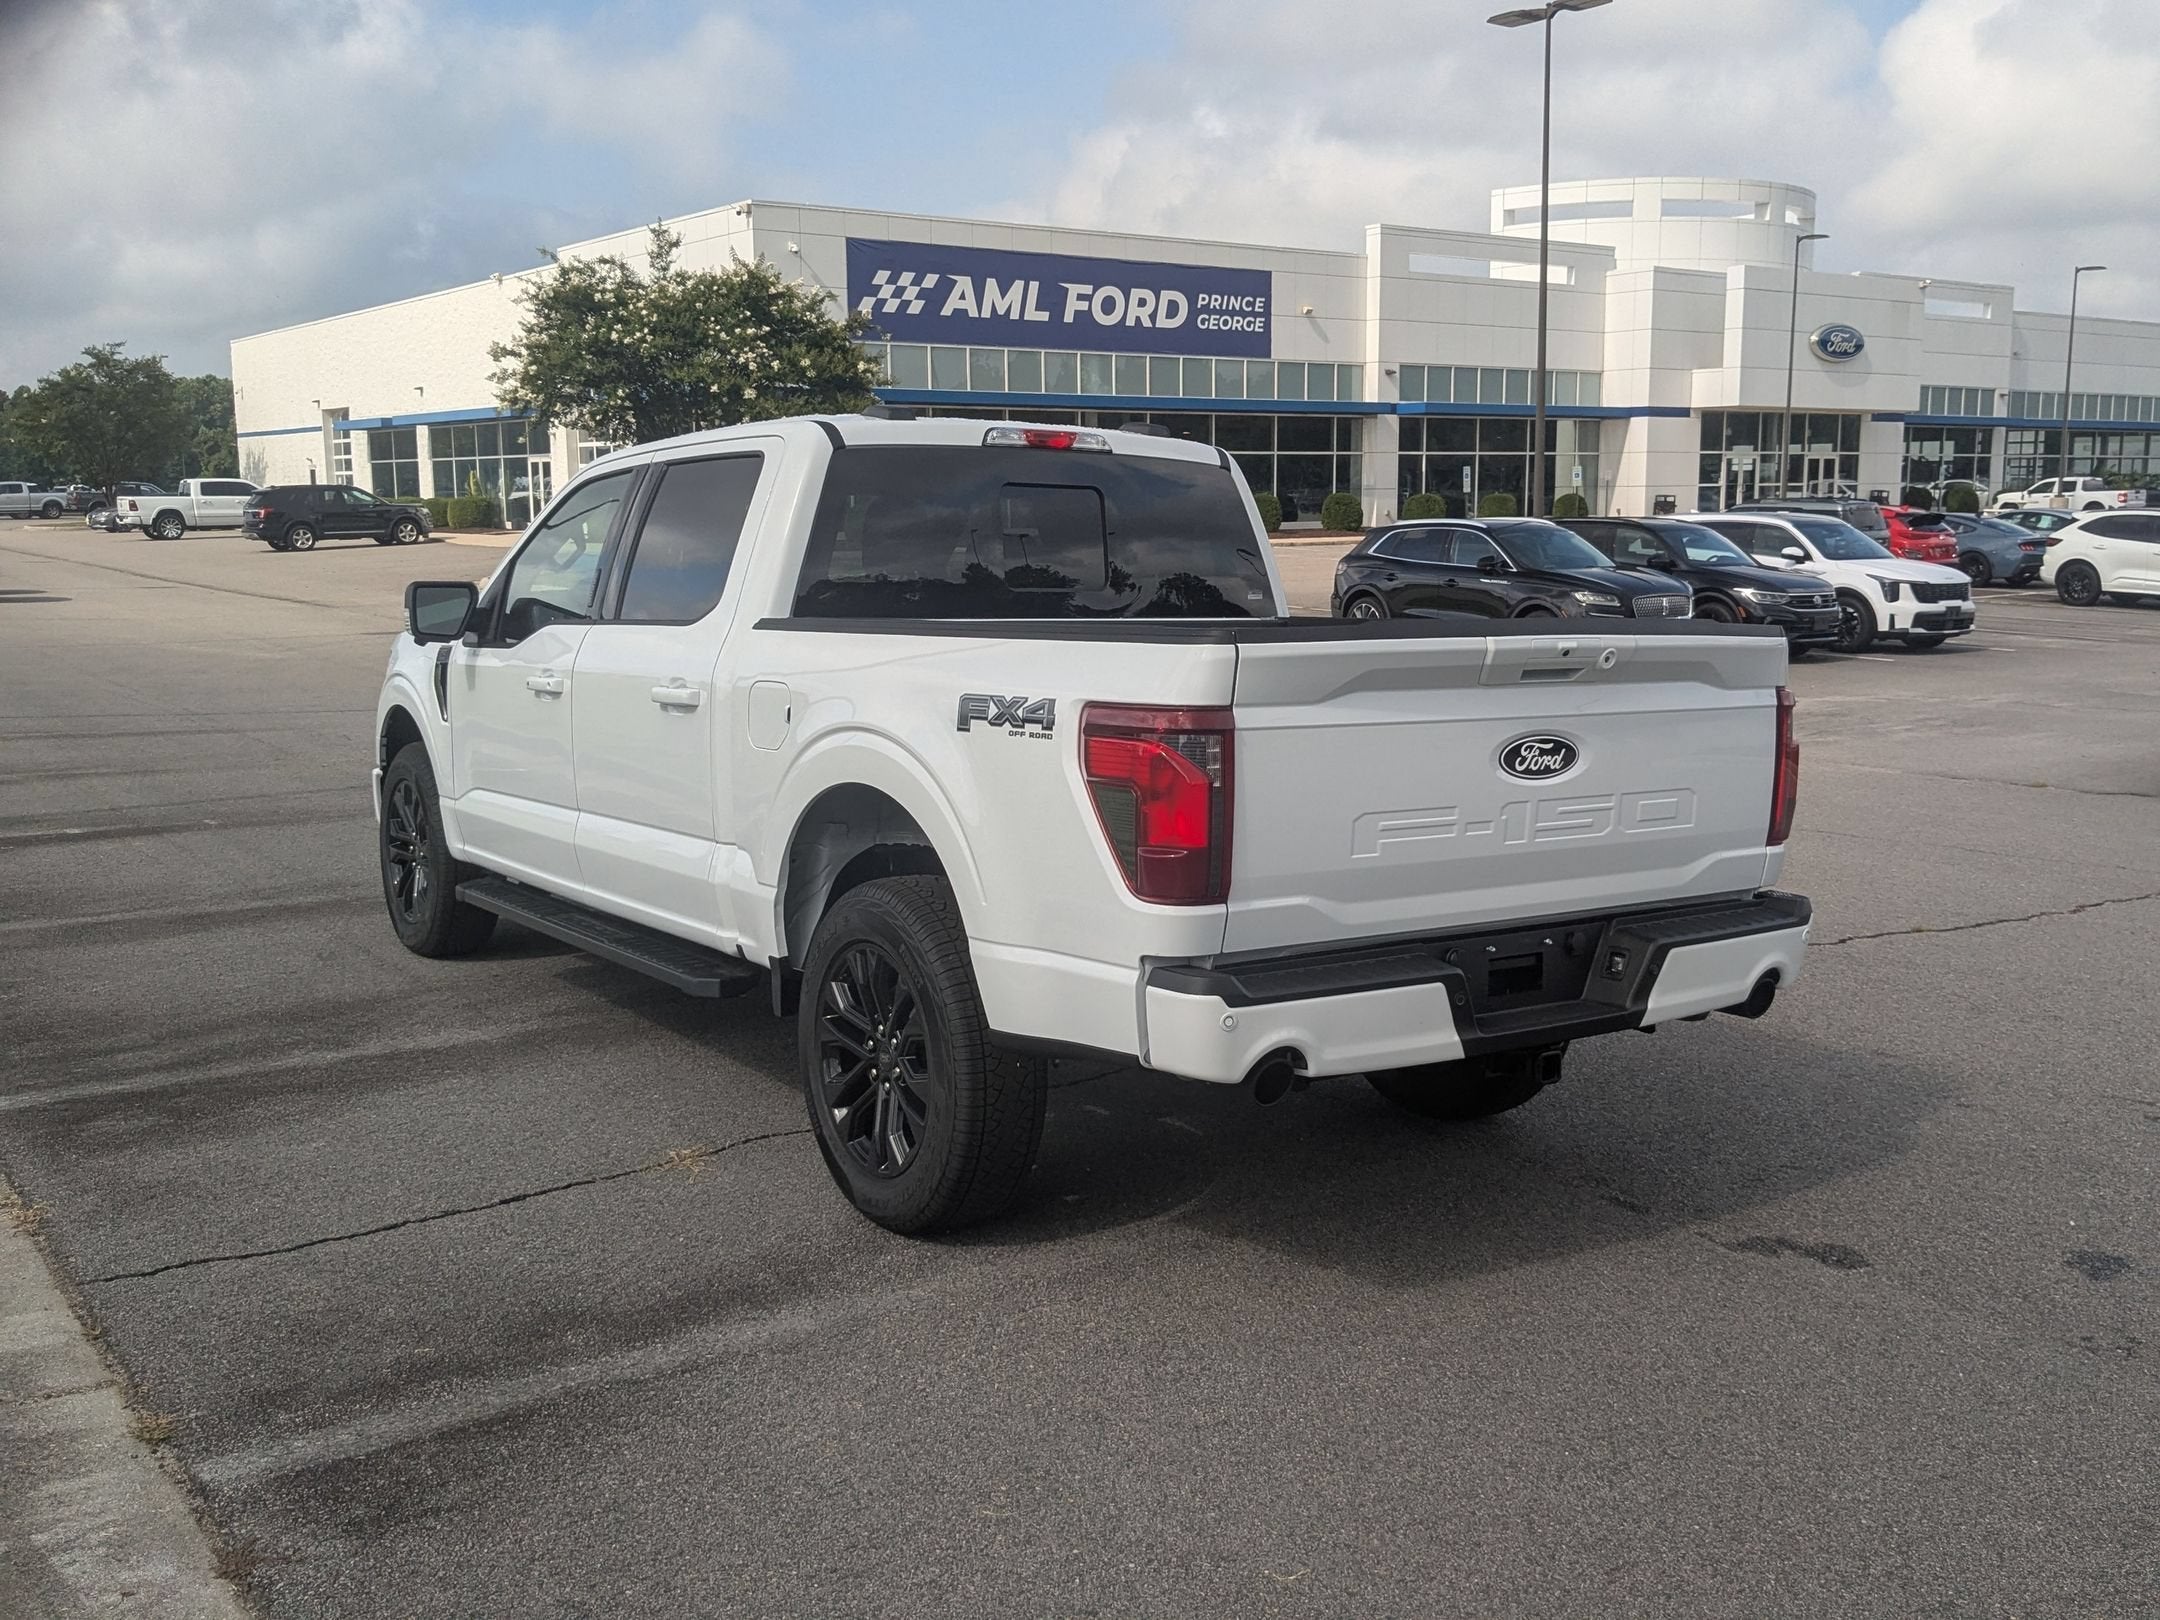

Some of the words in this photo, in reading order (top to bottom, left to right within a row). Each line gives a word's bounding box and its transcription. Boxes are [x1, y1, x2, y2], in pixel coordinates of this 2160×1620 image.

[939, 274, 1050, 322] AML
[1058, 282, 1189, 329] FORD
[1196, 293, 1266, 313] PRINCE
[1196, 313, 1265, 333] GEORGE
[1826, 331, 1857, 353] Ford
[957, 693, 1056, 732] FX4
[1008, 730, 1026, 738] OFF
[1028, 731, 1053, 740] ROAD
[1514, 742, 1566, 772] Ford
[1351, 787, 1697, 858] F-150
